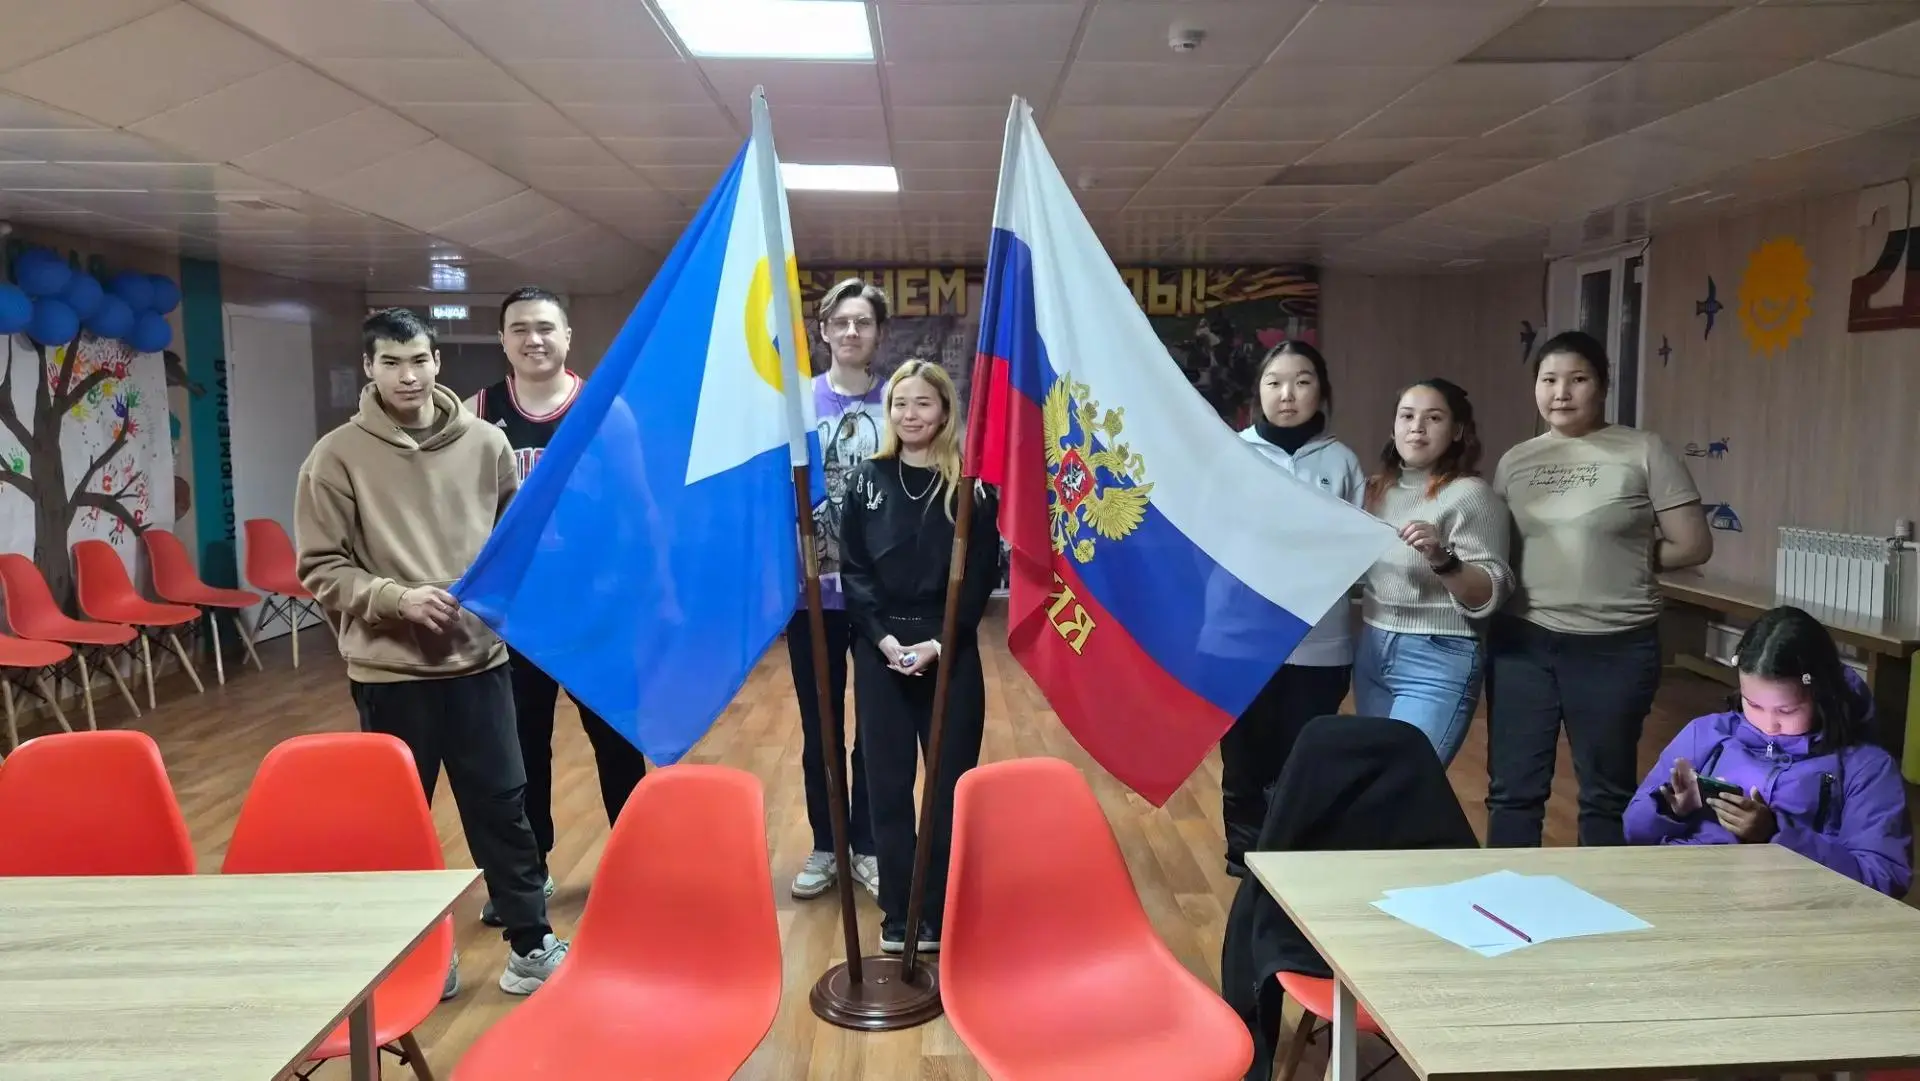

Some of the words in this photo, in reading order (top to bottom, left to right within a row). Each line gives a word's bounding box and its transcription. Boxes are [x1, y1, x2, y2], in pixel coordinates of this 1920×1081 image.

[433, 305, 467, 319] ВЫХОД
[834, 268, 966, 316] НЕМ
[214, 359, 236, 541] КОСТЮМЕРНАЯ
